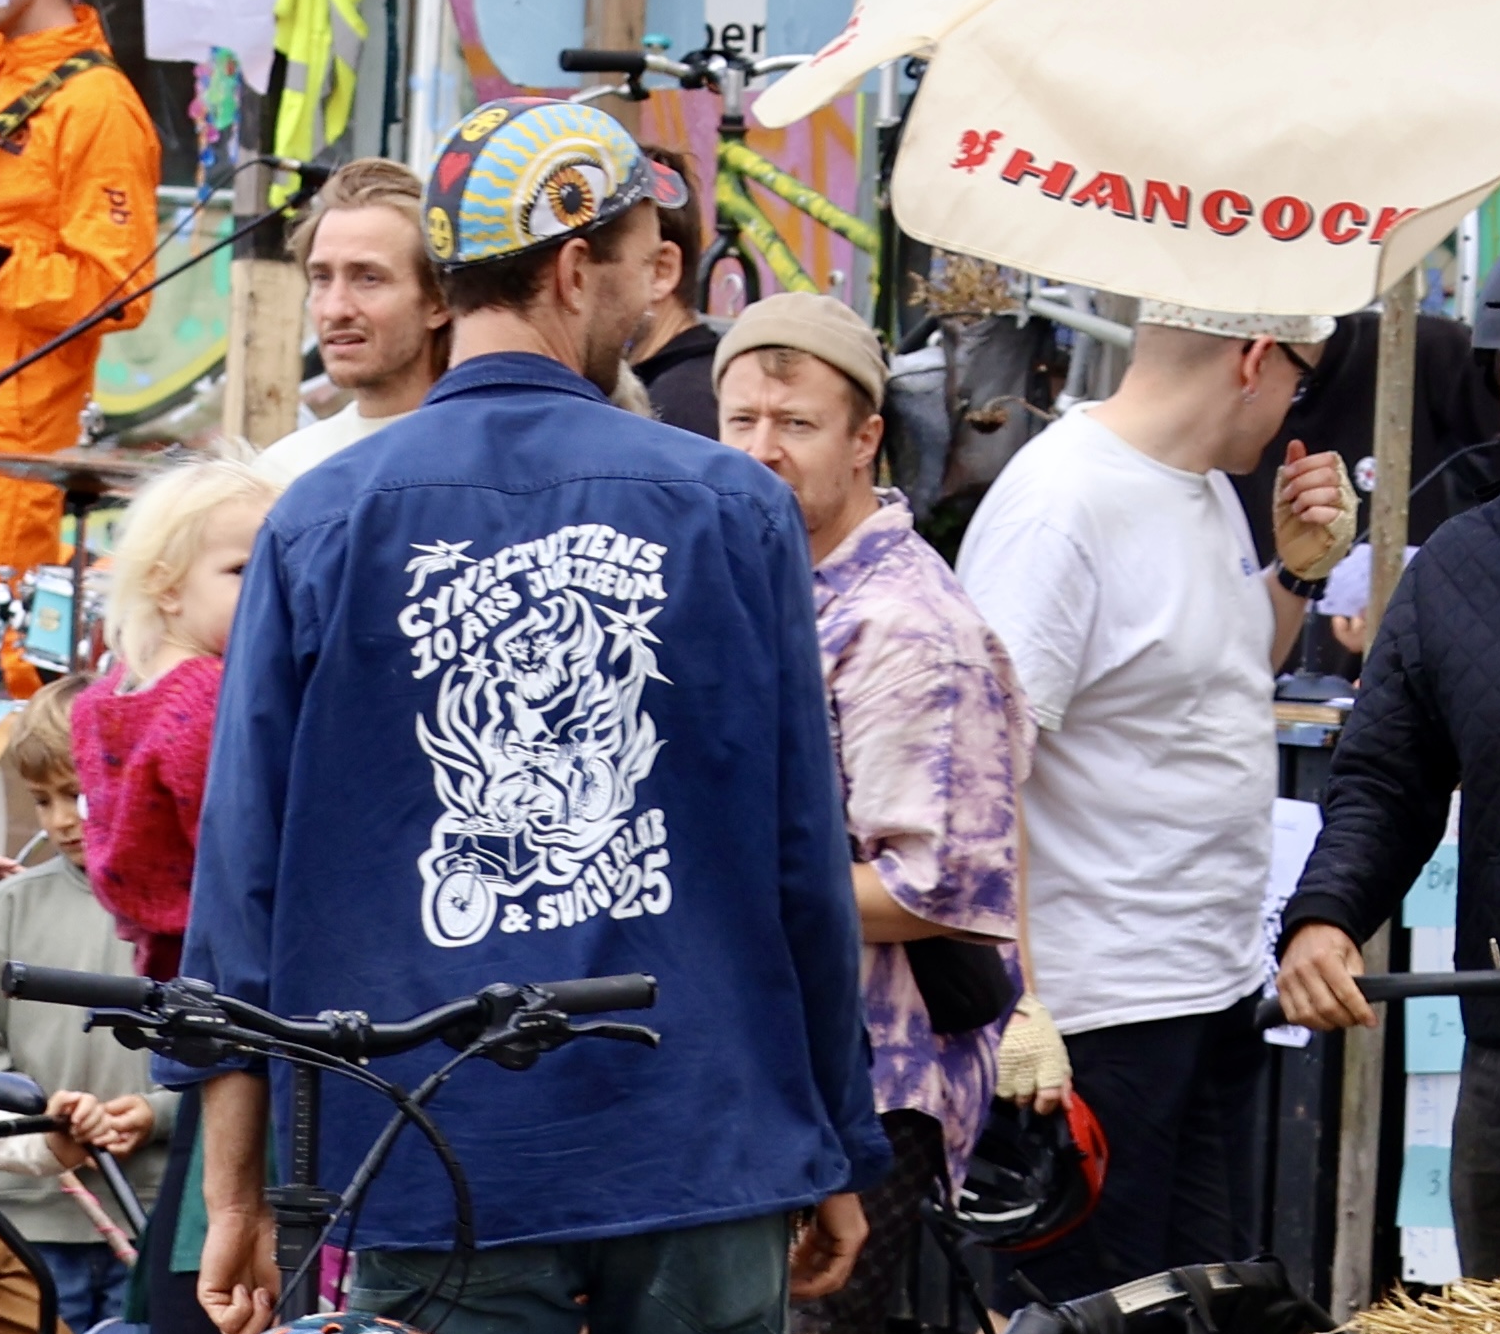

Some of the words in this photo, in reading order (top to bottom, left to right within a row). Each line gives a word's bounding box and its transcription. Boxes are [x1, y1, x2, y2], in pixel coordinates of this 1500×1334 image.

[398, 523, 669, 638] CYKELTUTTENS
[411, 627, 458, 680] 10
[460, 582, 522, 652] ÅRS
[500, 903, 532, 933] &
[611, 848, 673, 919] 25
